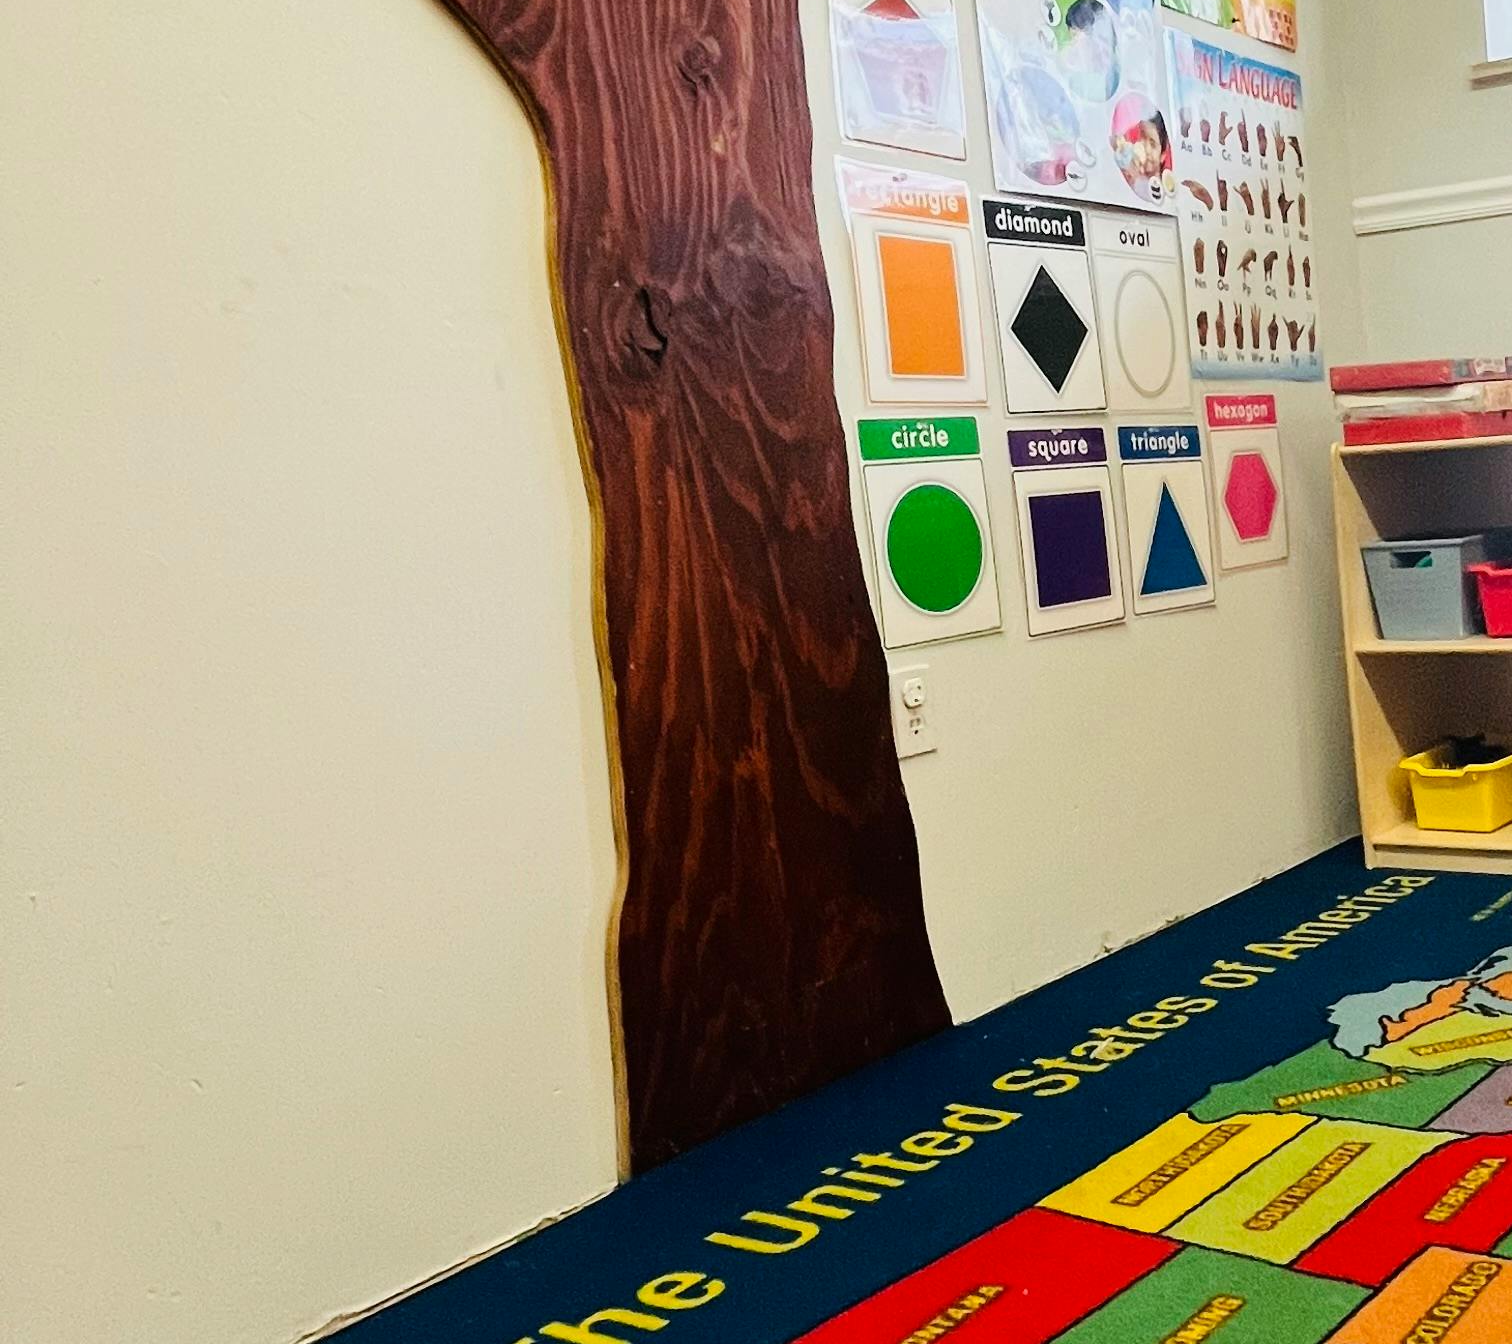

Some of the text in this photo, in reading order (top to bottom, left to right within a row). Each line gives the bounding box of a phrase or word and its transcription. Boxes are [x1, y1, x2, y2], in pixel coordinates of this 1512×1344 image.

[1217, 52, 1298, 111] LANGUAGE
[994, 207, 1074, 239] diamond
[1119, 229, 1151, 248] oval
[1213, 401, 1269, 422] hexagon
[891, 425, 950, 452] circle
[1027, 434, 1089, 462] square
[1130, 431, 1190, 456] triangle
[704, 1102, 1023, 1254] United
[992, 994, 1218, 1096] States
[1199, 959, 1277, 989] of
[1244, 875, 1437, 960] America
[1276, 1075, 1407, 1108] MINNESOTA
